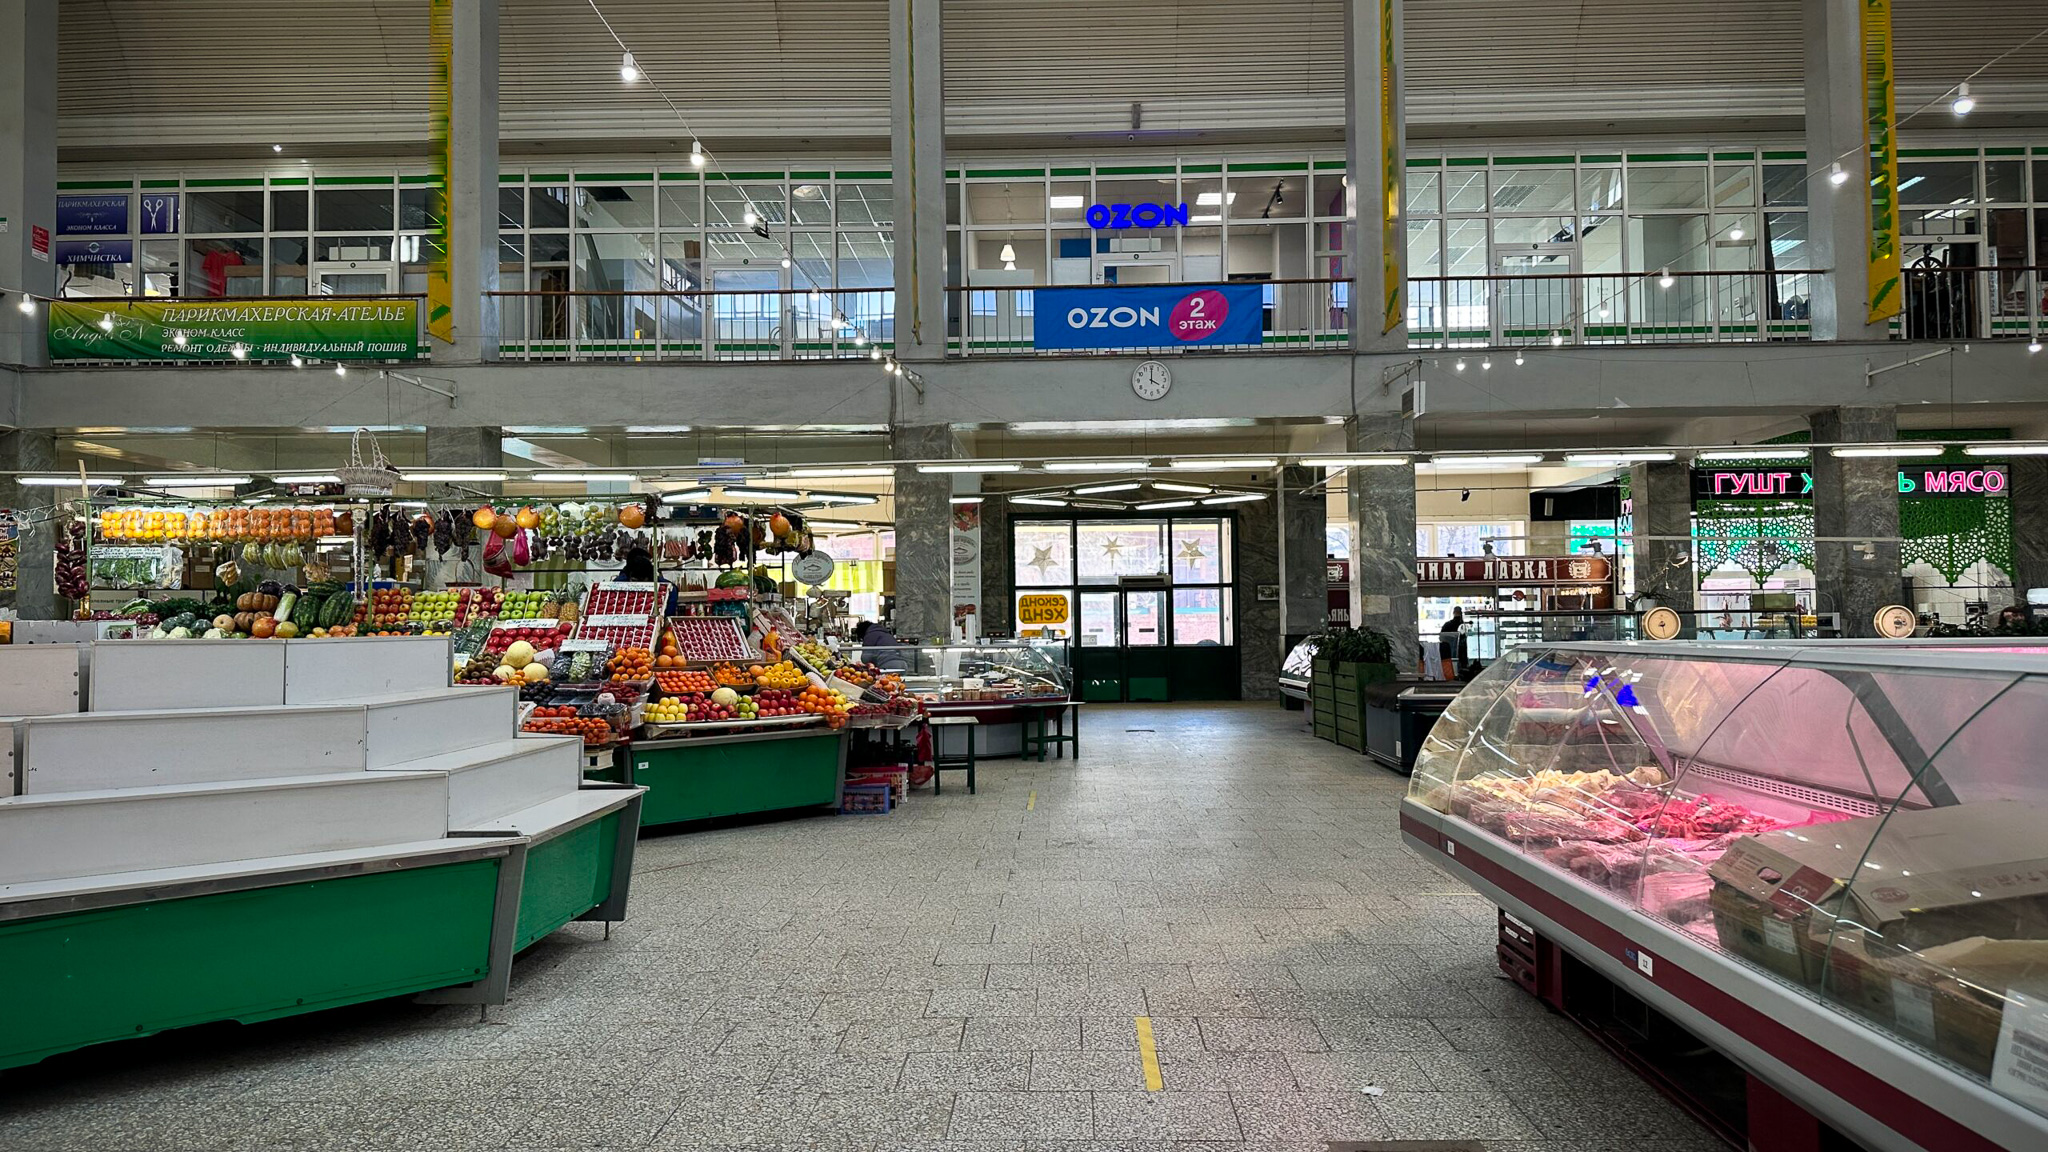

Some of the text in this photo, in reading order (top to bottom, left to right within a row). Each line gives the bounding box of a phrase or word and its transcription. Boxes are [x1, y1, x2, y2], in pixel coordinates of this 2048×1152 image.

[58, 200, 126, 208] ПАРИКМАХЕРСКАЯ
[1086, 203, 1188, 229] OZON
[67, 254, 122, 263] ХИМЧИСТКА
[1189, 297, 1205, 318] 2
[1067, 306, 1160, 329] OZON
[1178, 319, 1217, 330] этаж
[210, 328, 245, 337] КЛАСС
[161, 343, 204, 353] РЕМОНТ
[262, 341, 365, 353] ИНДИВИДУАЛЬНЫЙ
[366, 343, 408, 352] ПОШИВ
[1714, 472, 1792, 495] ГУШТ
[1924, 470, 2005, 493] МЯСО
[1483, 560, 1548, 580] ЛАВКА
